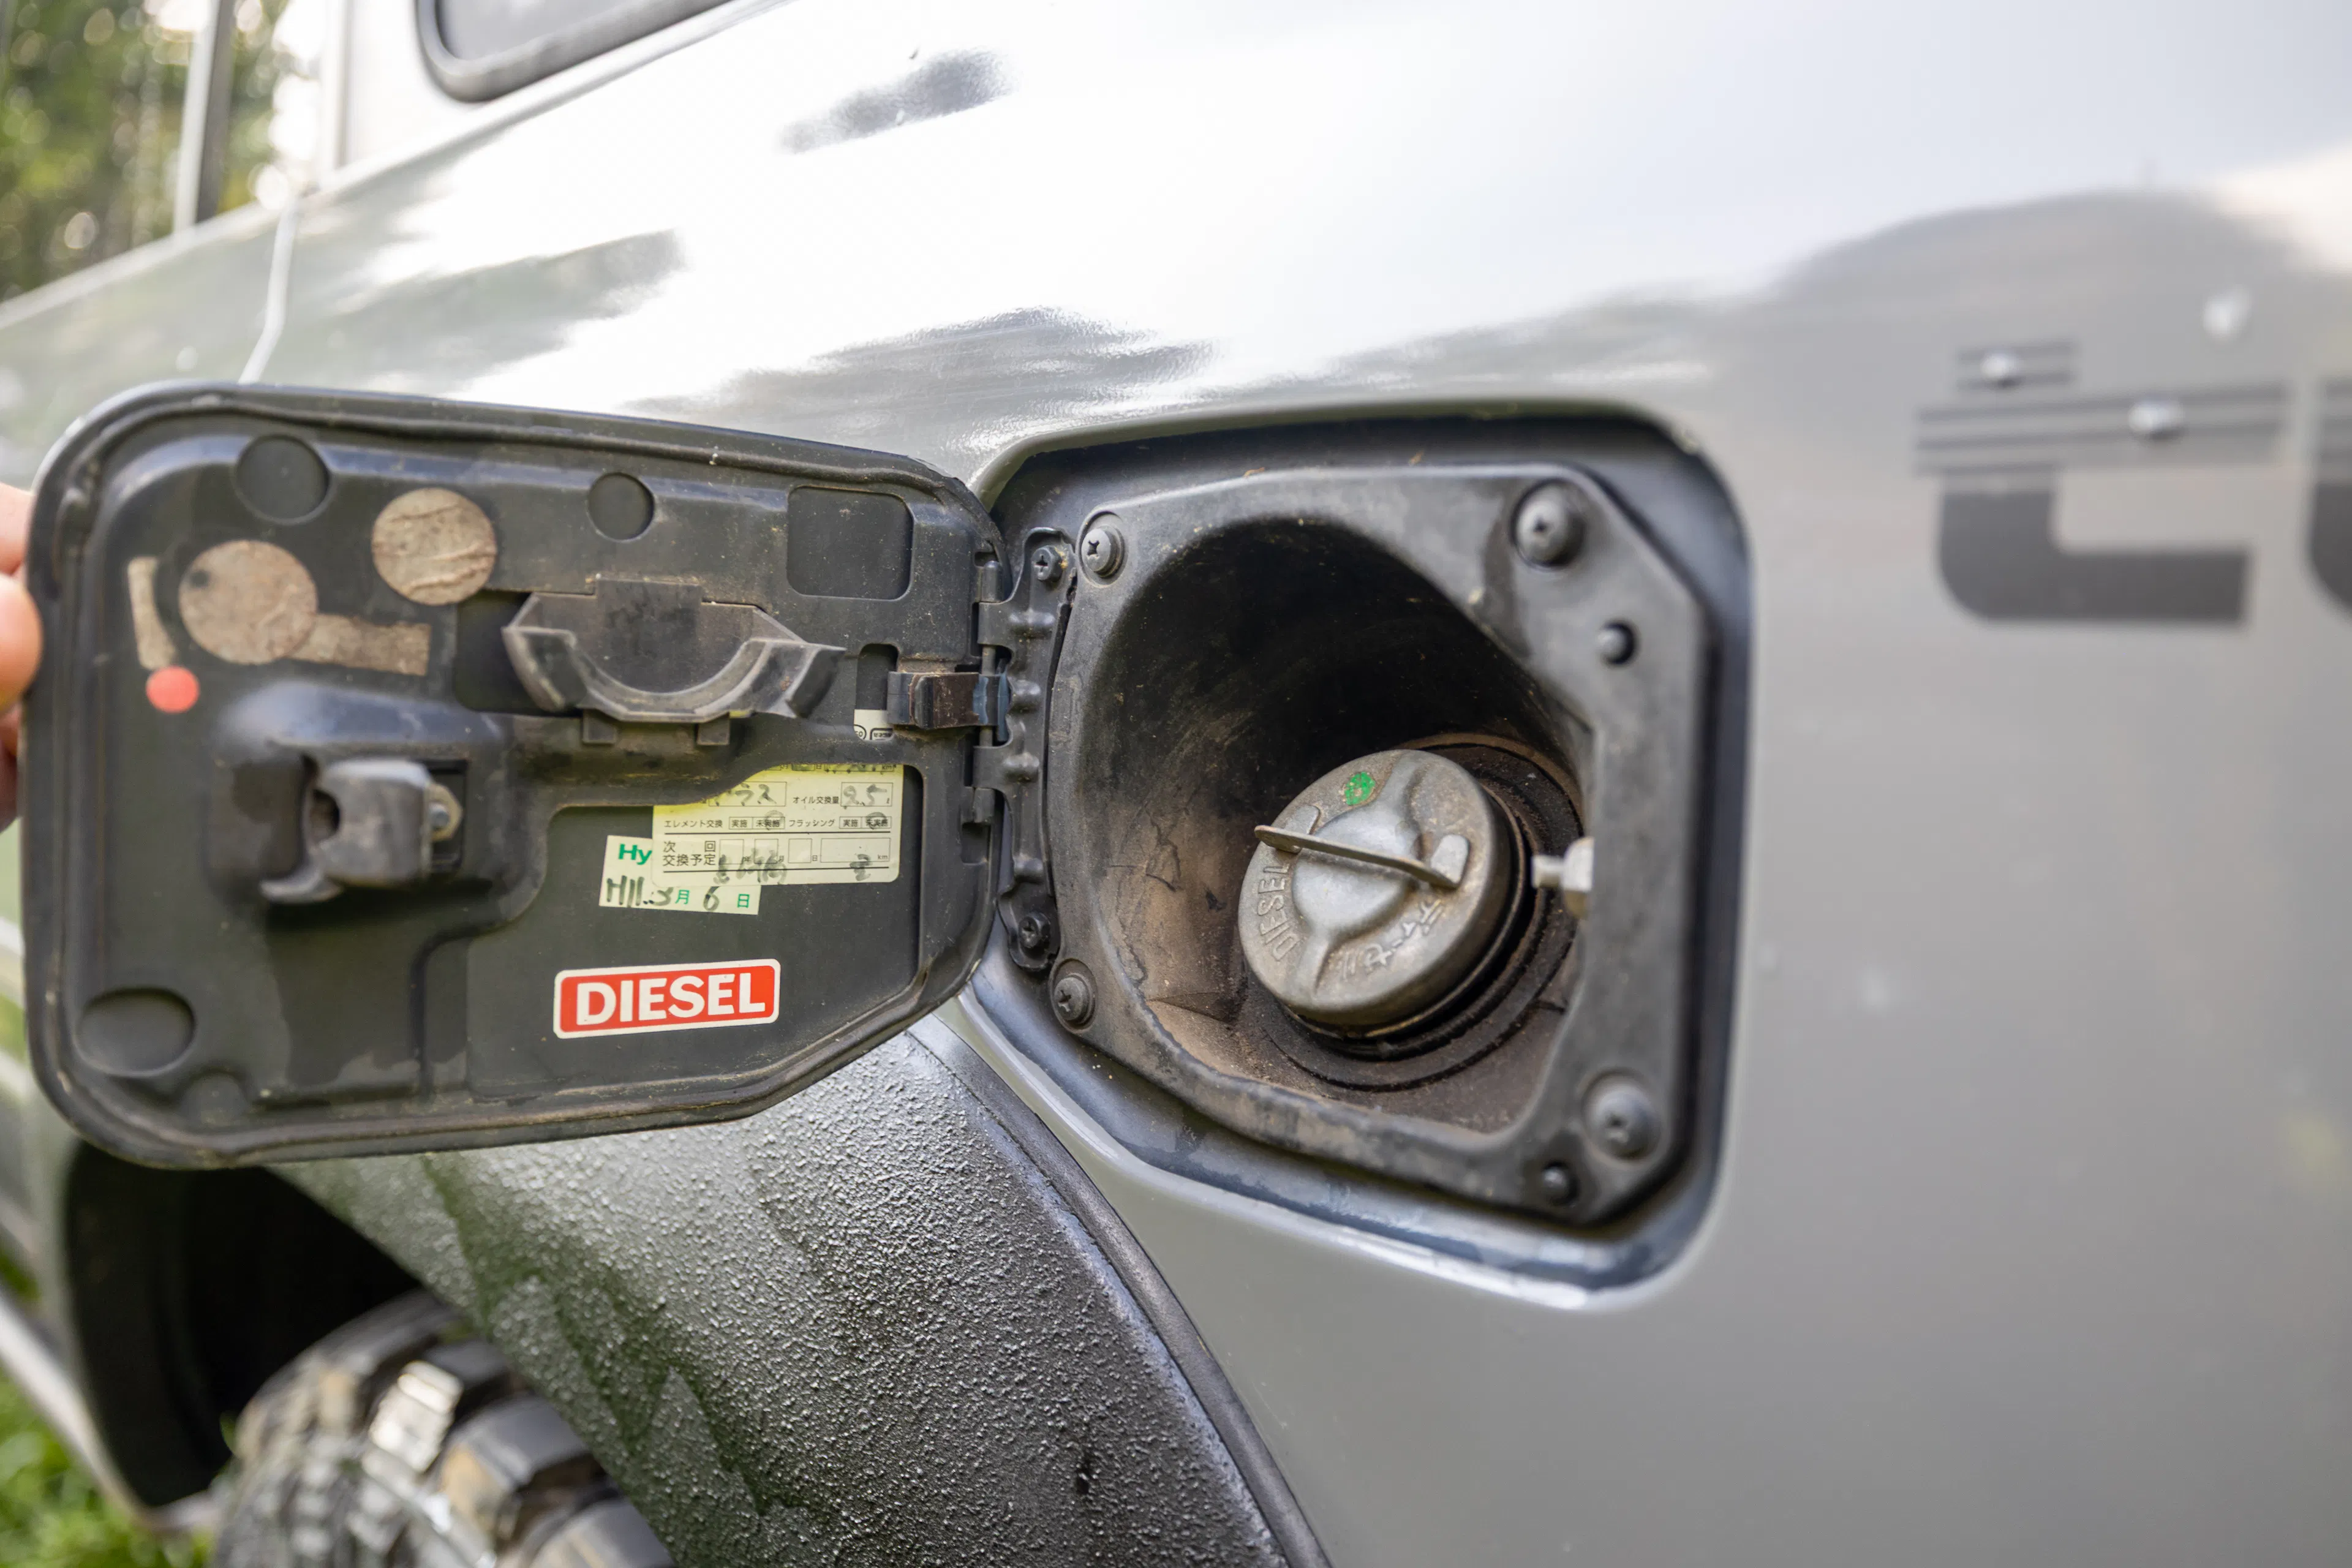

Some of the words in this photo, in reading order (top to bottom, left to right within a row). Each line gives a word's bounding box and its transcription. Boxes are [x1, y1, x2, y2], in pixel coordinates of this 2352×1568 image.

[732, 819, 748, 827] 実施
[756, 819, 780, 828] 未実施
[789, 819, 835, 827] フラッシング
[866, 818, 888, 827] 未実施
[663, 840, 676, 853] 次
[705, 840, 716, 853] 回
[663, 854, 717, 867] 交換予定
[675, 889, 690, 905] 月
[737, 894, 750, 908] 日
[576, 972, 766, 1026] DIESEL
